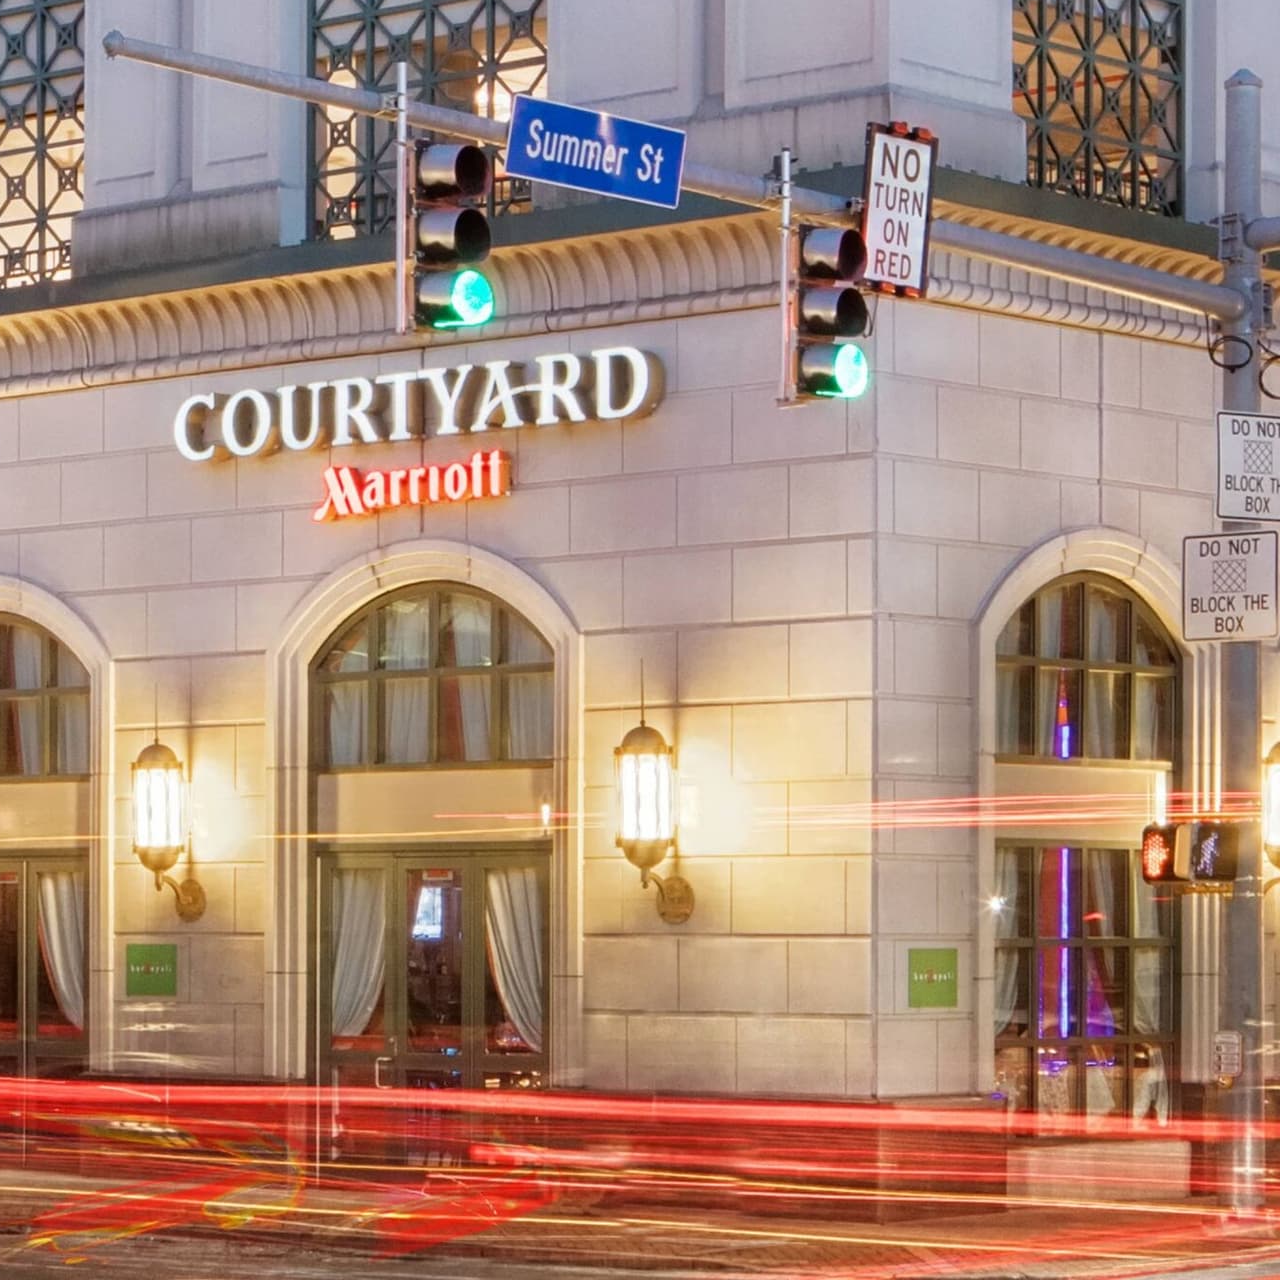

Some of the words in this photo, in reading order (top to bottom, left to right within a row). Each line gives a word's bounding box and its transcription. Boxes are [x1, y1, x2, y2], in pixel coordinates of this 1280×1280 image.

[525, 117, 628, 176] Summer
[636, 142, 665, 185] St
[881, 142, 921, 183] NO
[874, 182, 924, 217] TURN
[883, 218, 910, 248] ON
[874, 249, 912, 280] RED
[173, 346, 650, 462] COURTYARD
[1231, 419, 1250, 436] DO
[313, 449, 511, 522] Marriott
[1224, 475, 1265, 493] BLOCK
[1244, 496, 1271, 513] BOX
[1199, 541, 1221, 557] DO
[1228, 538, 1260, 554] NOT
[1190, 596, 1235, 614] BLOCK
[1243, 594, 1269, 610] THE
[1214, 616, 1245, 633] BOX
